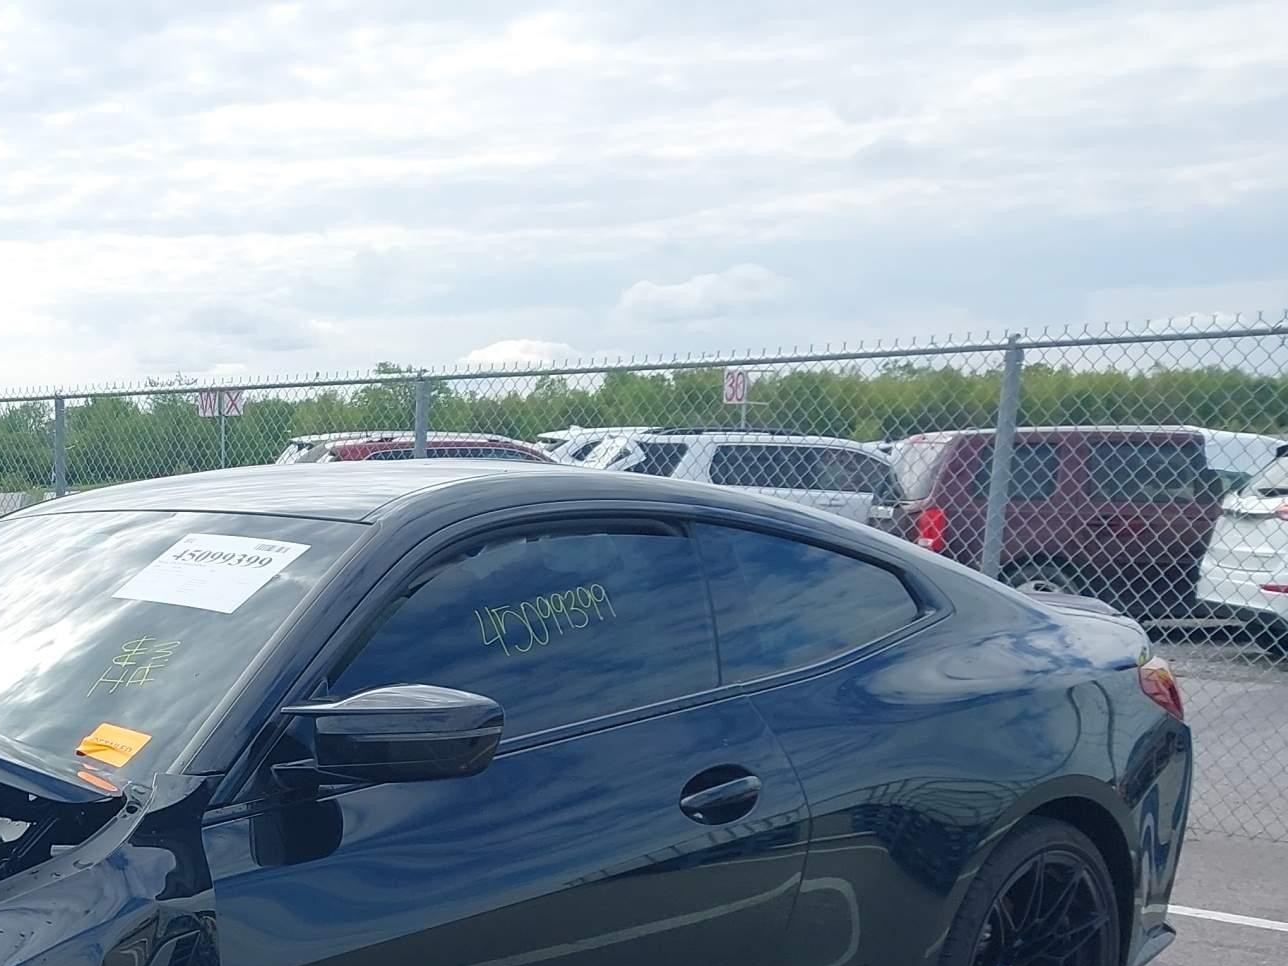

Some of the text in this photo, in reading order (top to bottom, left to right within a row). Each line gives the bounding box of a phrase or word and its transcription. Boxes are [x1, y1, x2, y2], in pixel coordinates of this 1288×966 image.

[725, 371, 746, 402] 30
[199, 391, 242, 417] W X
[172, 548, 274, 569] 45099399
[474, 583, 617, 657] 45099399
